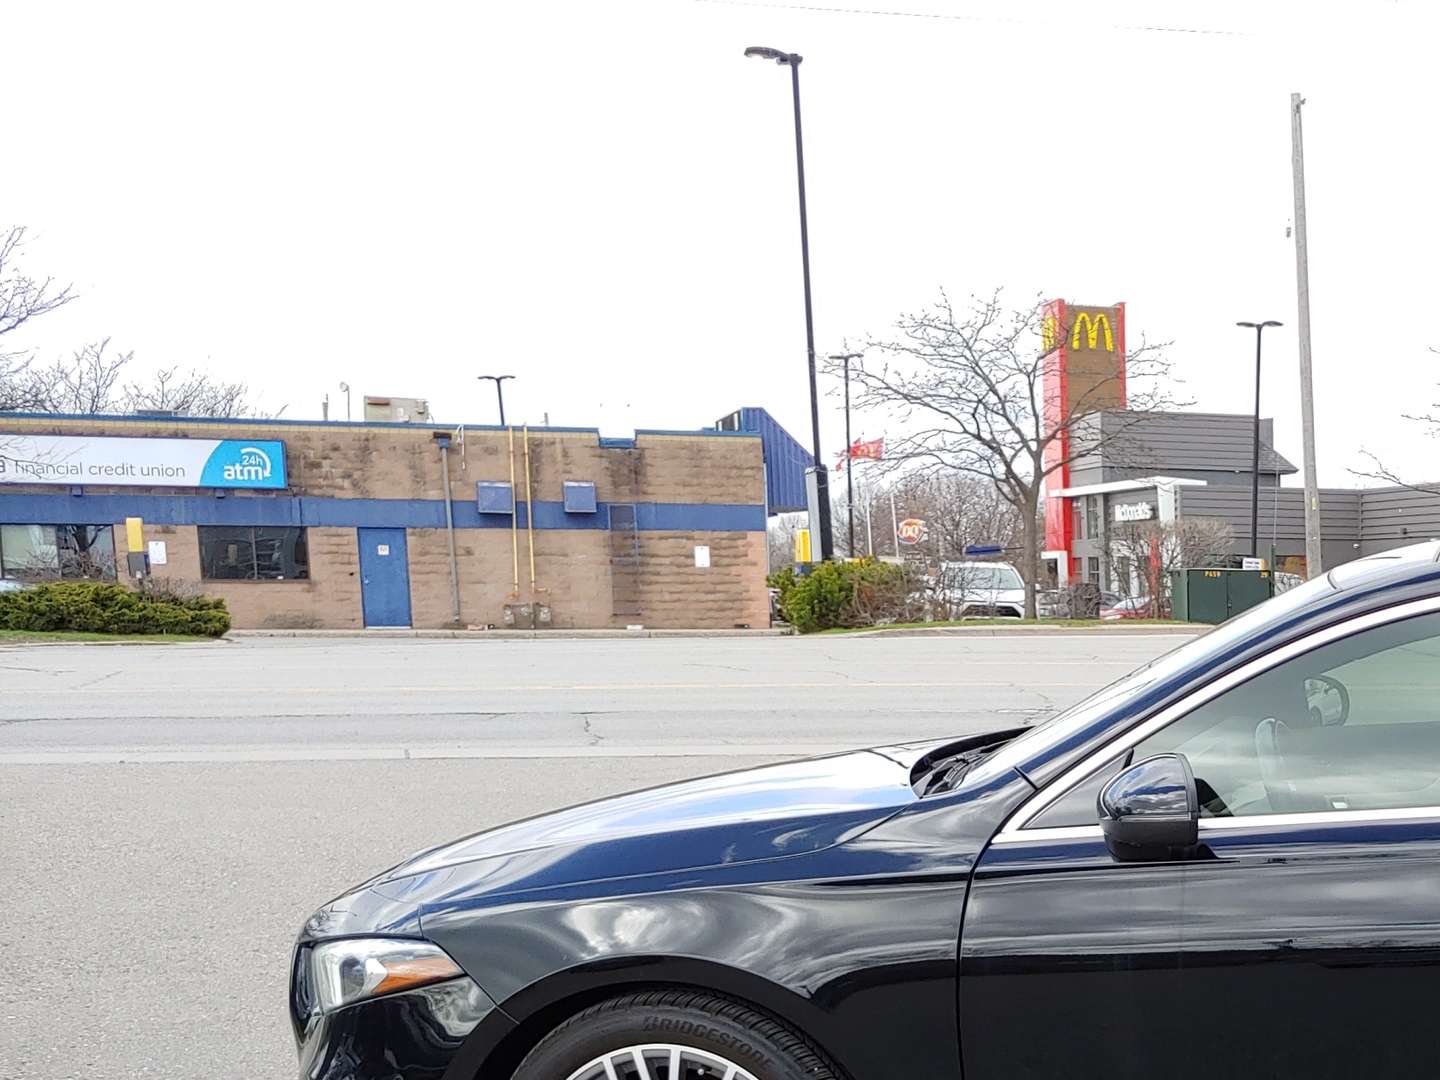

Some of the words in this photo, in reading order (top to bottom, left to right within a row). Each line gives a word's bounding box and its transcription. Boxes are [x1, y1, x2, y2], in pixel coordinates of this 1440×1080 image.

[242, 454, 263, 465] 24h
[89, 460, 135, 477] credit
[140, 462, 186, 478] union
[224, 464, 263, 480] atm
[902, 525, 919, 538] DQ
